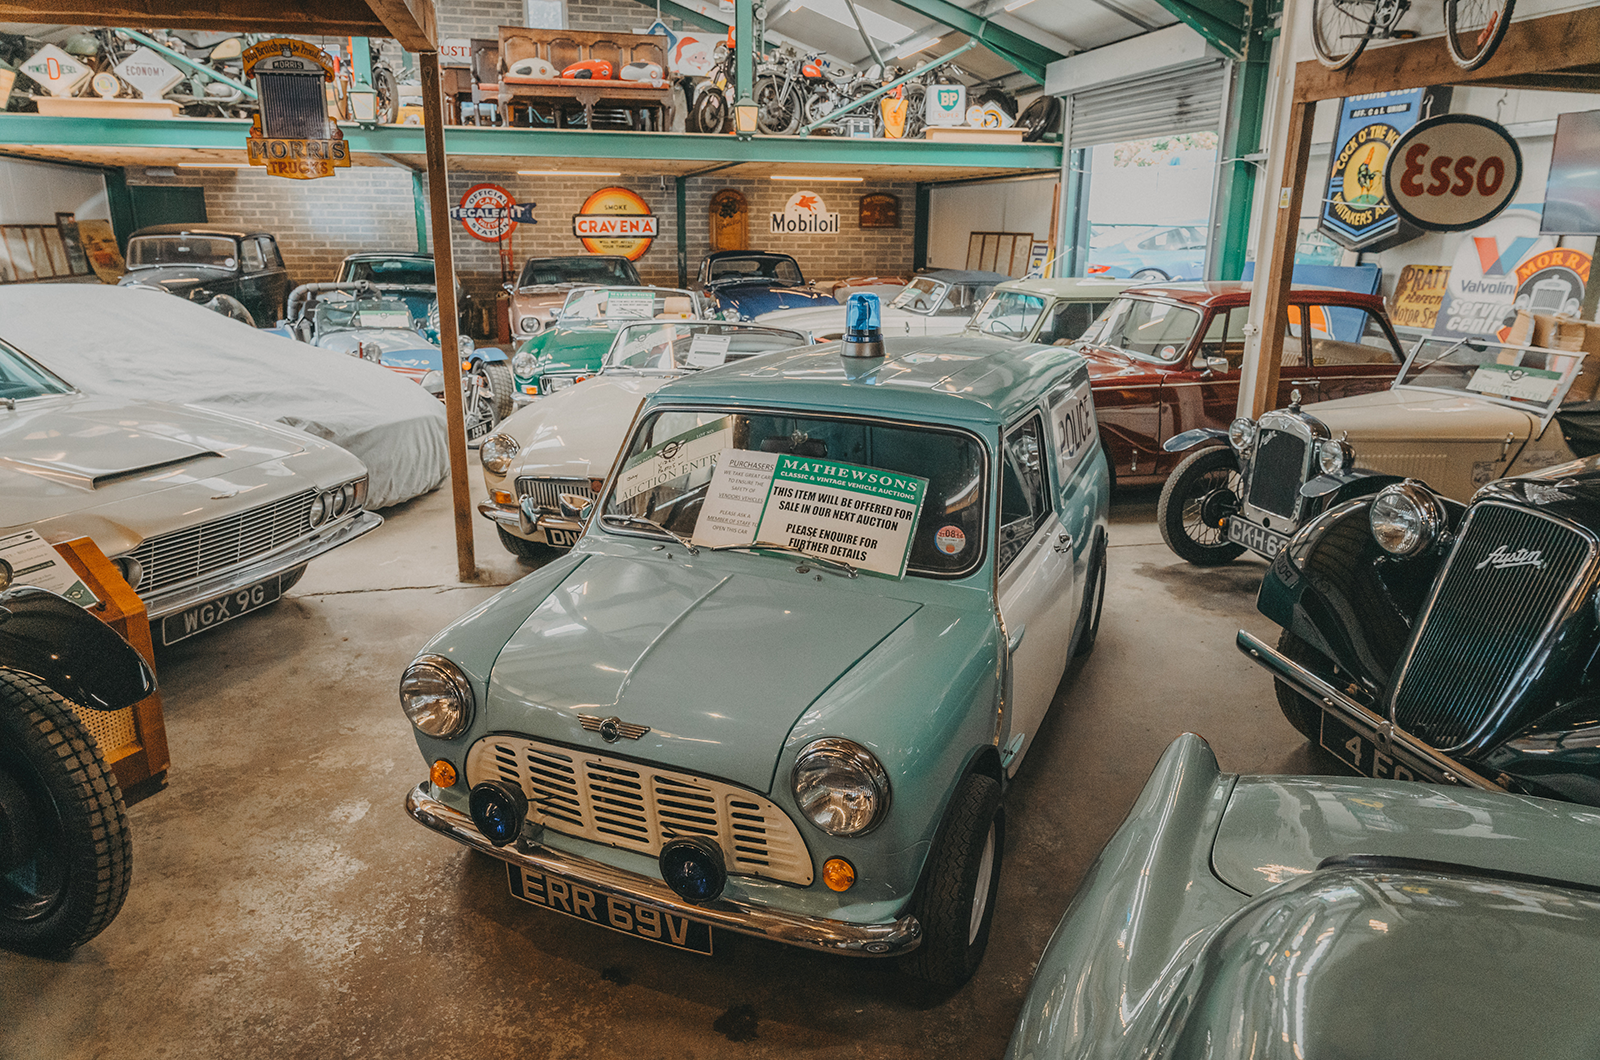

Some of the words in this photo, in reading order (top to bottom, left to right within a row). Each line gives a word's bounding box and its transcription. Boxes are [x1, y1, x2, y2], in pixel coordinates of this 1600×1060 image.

[126, 66, 166, 76] ECONOMY
[940, 92, 958, 106] BP
[250, 141, 346, 160] MORRIS
[1336, 136, 1358, 170] COCK
[1370, 125, 1388, 139] THE
[270, 162, 328, 174] TRUCKS
[469, 190, 507, 204] OFFICIAL
[471, 222, 510, 236] STATION
[578, 220, 640, 233] CRAVEN
[772, 214, 839, 232] Mobiloil
[1461, 280, 1515, 294] Valvolin
[1058, 394, 1092, 468] POLICE
[729, 459, 774, 470] PURCHASERS
[783, 459, 918, 492] MATHEWSONS
[622, 470, 677, 501] AUCTION
[780, 471, 809, 481] CLASSIC
[809, 474, 815, 482] &
[816, 476, 846, 487] VINTAGE
[848, 481, 877, 493] VEHICLE
[878, 487, 915, 500] AUCTIONS
[718, 492, 739, 500] VENDORS
[773, 486, 793, 498] THIS
[794, 490, 816, 502] ITEM
[818, 493, 840, 506] WILL
[841, 497, 852, 508] BE
[854, 500, 893, 516] OFFERED
[894, 507, 912, 520] FOR
[707, 515, 726, 524] MEMBER
[720, 509, 736, 517] PLEASE
[779, 501, 799, 512] SALE
[801, 504, 811, 514] IN
[812, 506, 832, 518] OUR
[833, 510, 856, 523] NEXT
[856, 514, 898, 531] AUCTION
[552, 529, 582, 546] DN
[786, 523, 818, 537] PLEASE
[819, 529, 859, 545] ENQUIRE
[860, 536, 878, 549] FOR
[946, 530, 955, 538] 08
[788, 538, 828, 555] FURTHER
[830, 545, 867, 561] DETAILS
[184, 596, 230, 634] WGX
[236, 584, 264, 611] 9G
[1345, 736, 1362, 766] 4
[520, 866, 598, 920] ERR
[607, 896, 689, 945] 69V
